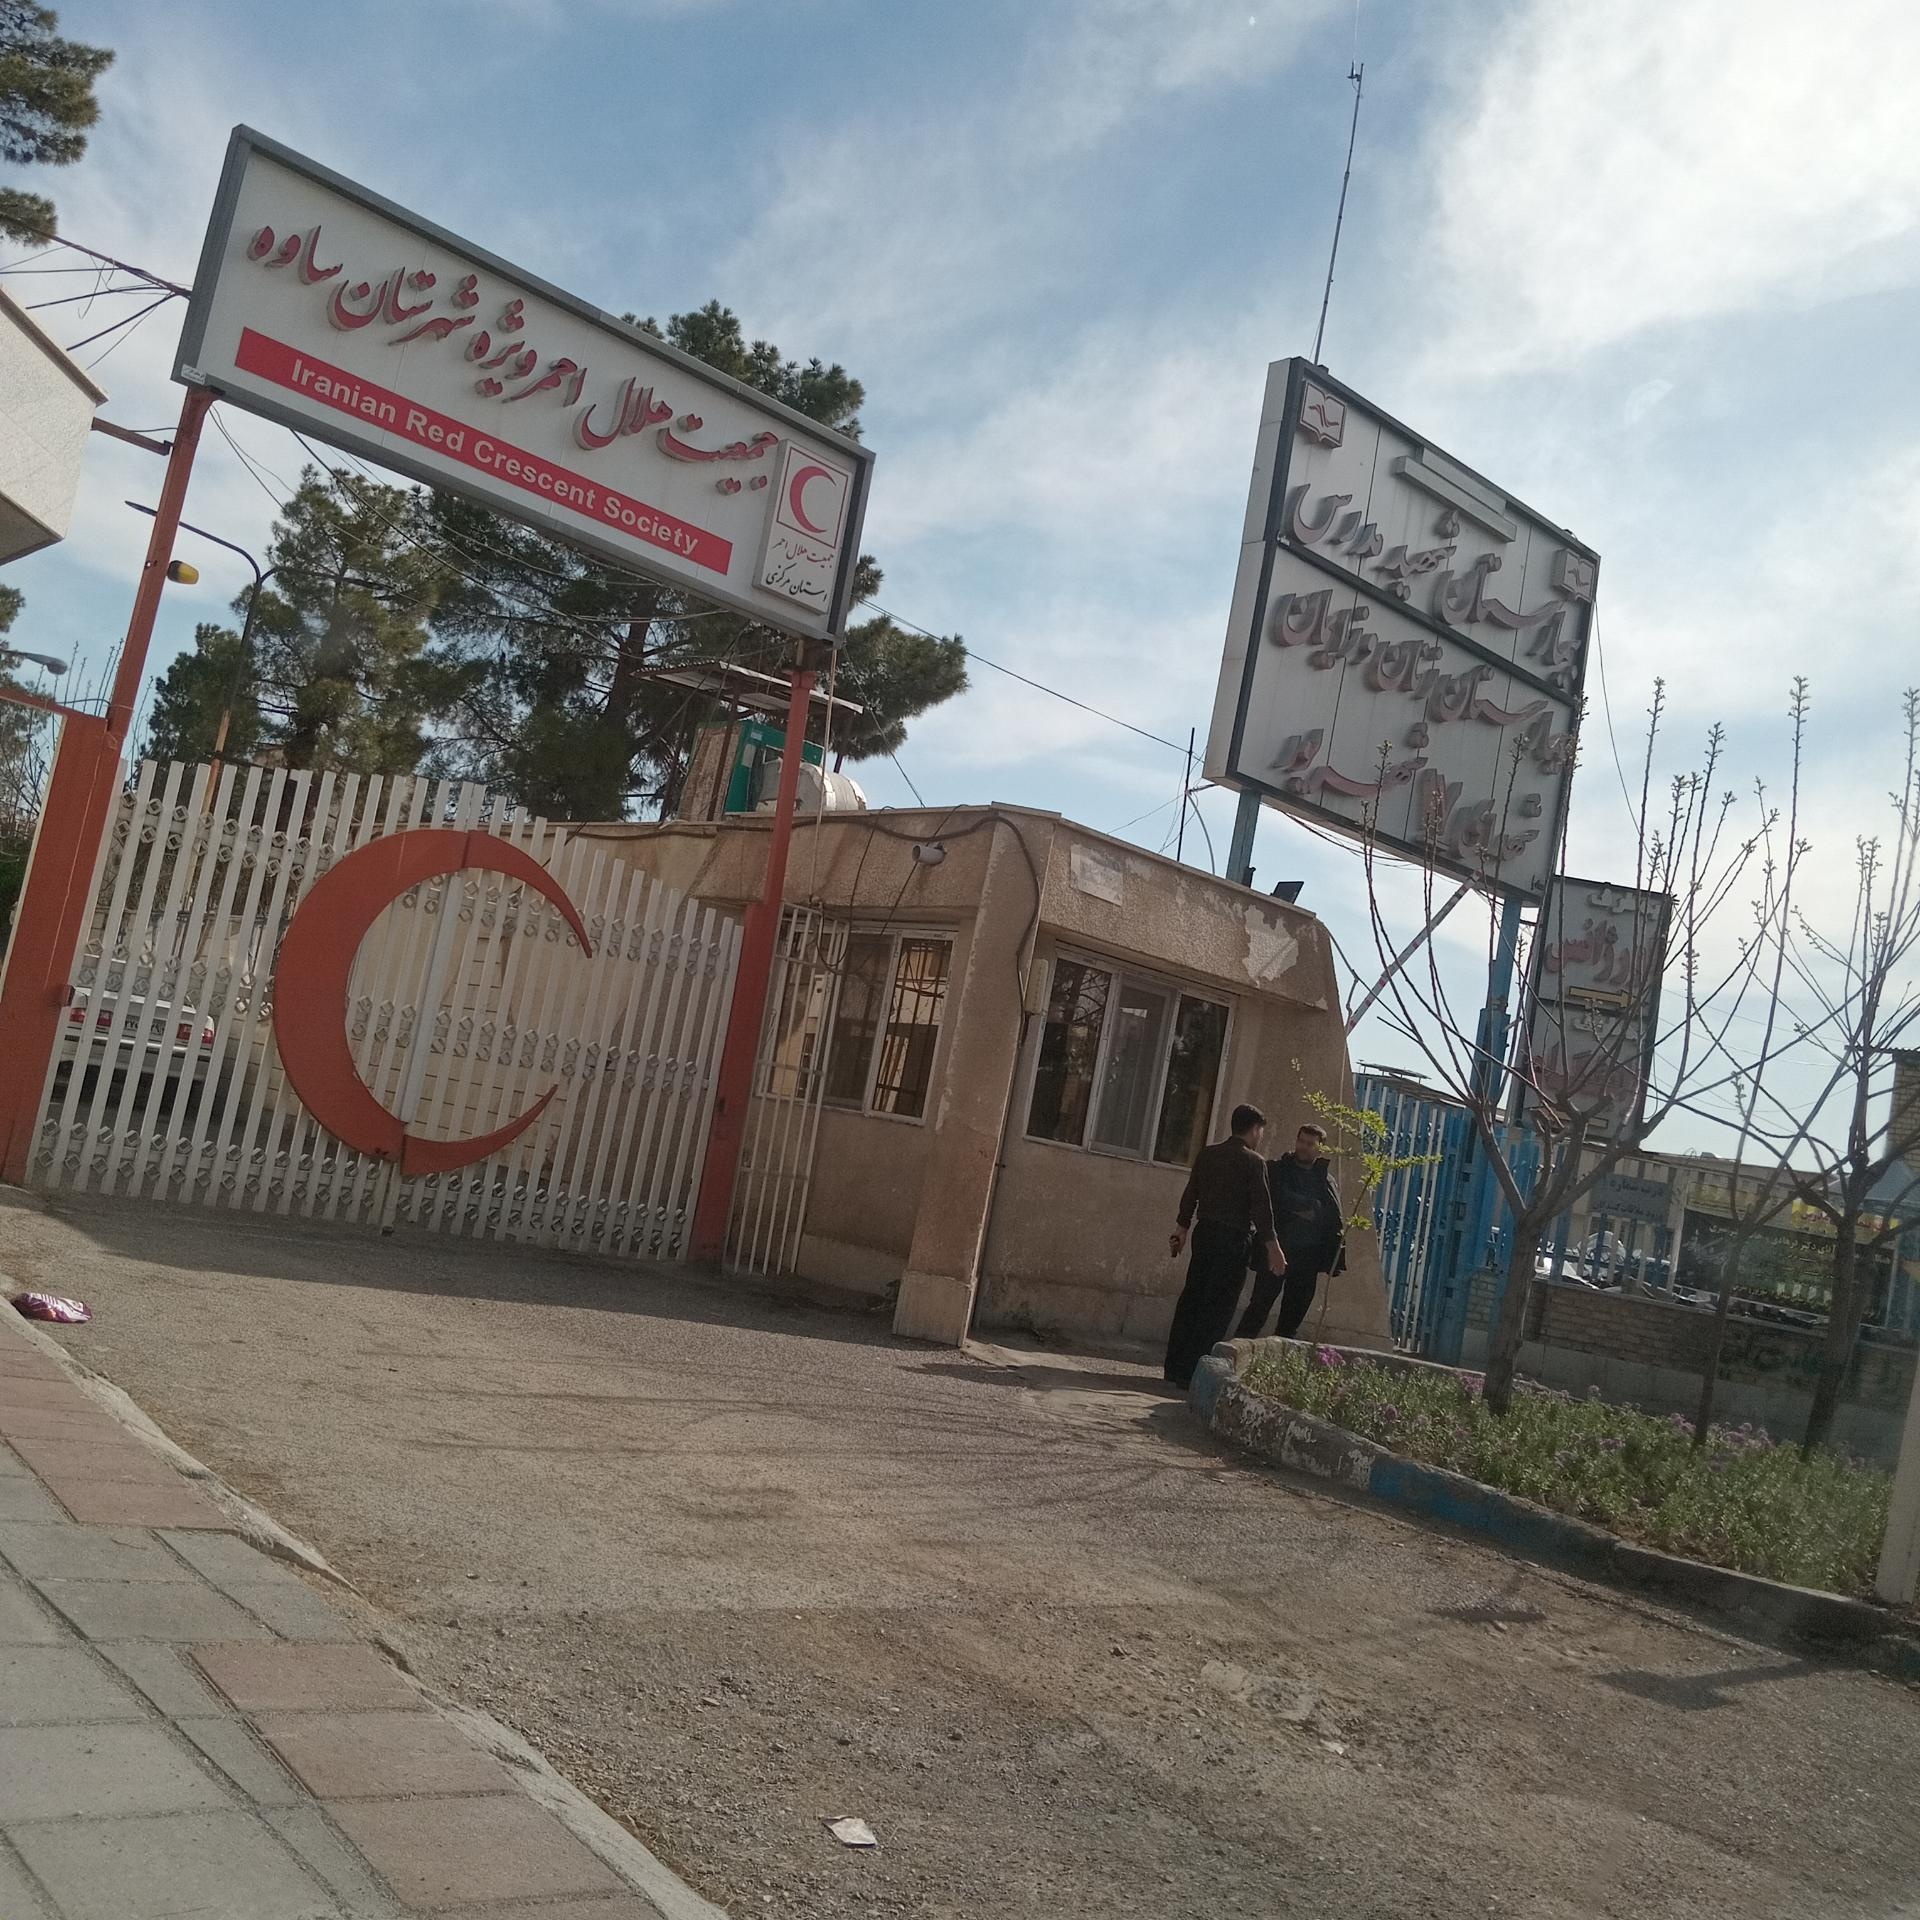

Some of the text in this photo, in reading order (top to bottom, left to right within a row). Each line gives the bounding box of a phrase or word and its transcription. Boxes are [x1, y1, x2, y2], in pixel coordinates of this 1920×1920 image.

[249, 225, 343, 285] ساوه
[328, 267, 480, 346] شهرستان
[502, 358, 587, 407] احمر
[573, 377, 674, 450] هلال
[291, 359, 699, 555] Iranian Red Crescent Society
[657, 413, 778, 495] جمعیت
[765, 562, 828, 602] استان مرکزی
[772, 537, 834, 568] جمعیت هلال احمر
[1288, 482, 1581, 693] بیمارستان شهید مدرس
[1273, 588, 1370, 670] زایمان
[1430, 664, 1573, 775] بیمارستان
[1545, 919, 1657, 985] رژانس
